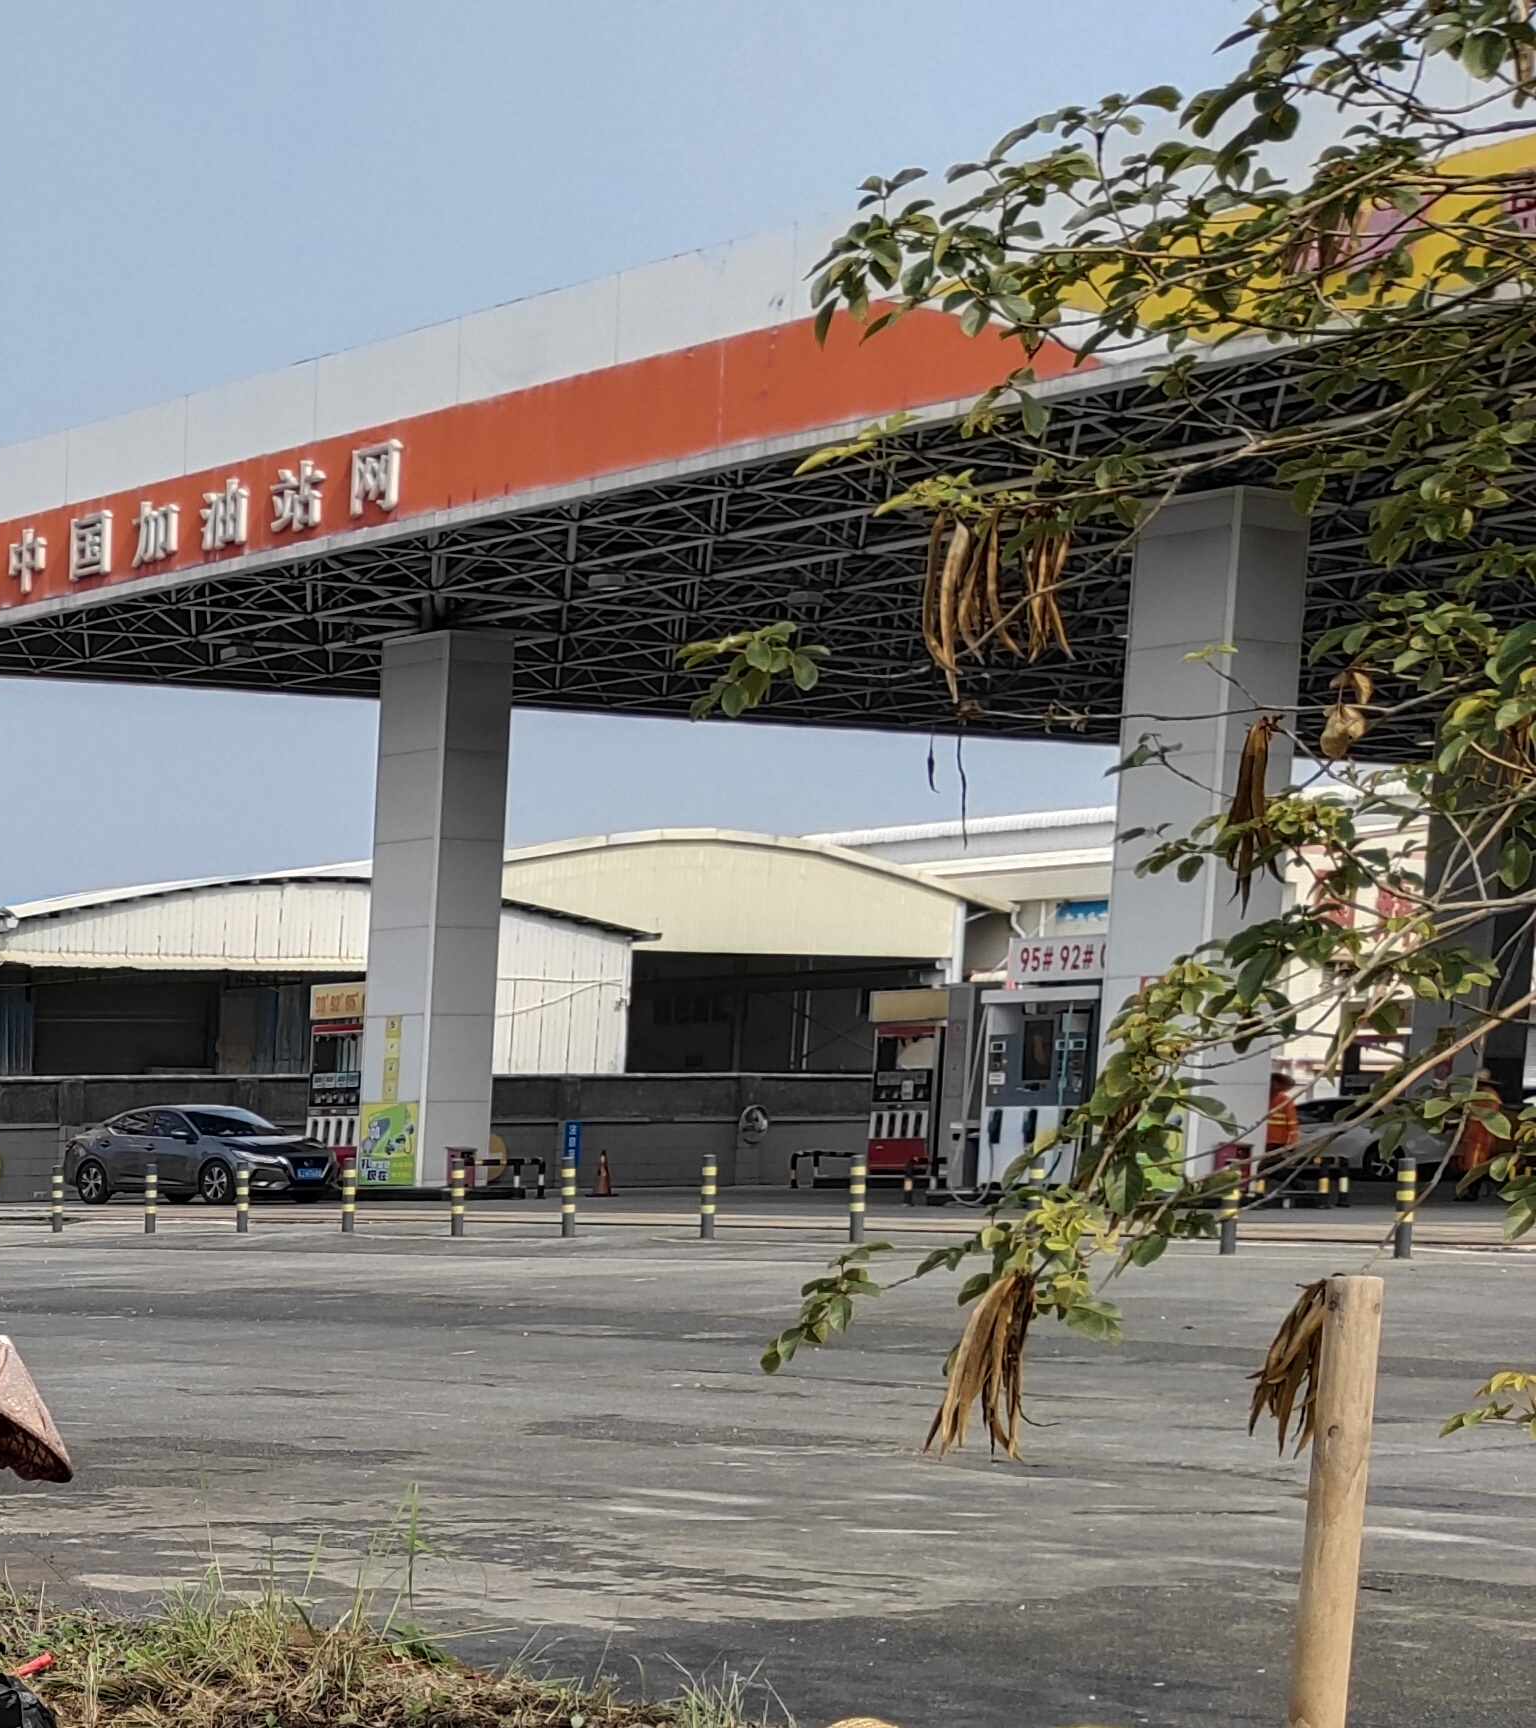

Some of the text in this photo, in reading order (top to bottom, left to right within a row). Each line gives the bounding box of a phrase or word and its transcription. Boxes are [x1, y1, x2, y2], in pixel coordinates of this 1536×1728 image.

[8, 438, 404, 595] 中国加油站网
[1019, 946, 1054, 972] 95#
[1059, 944, 1094, 971] 92#
